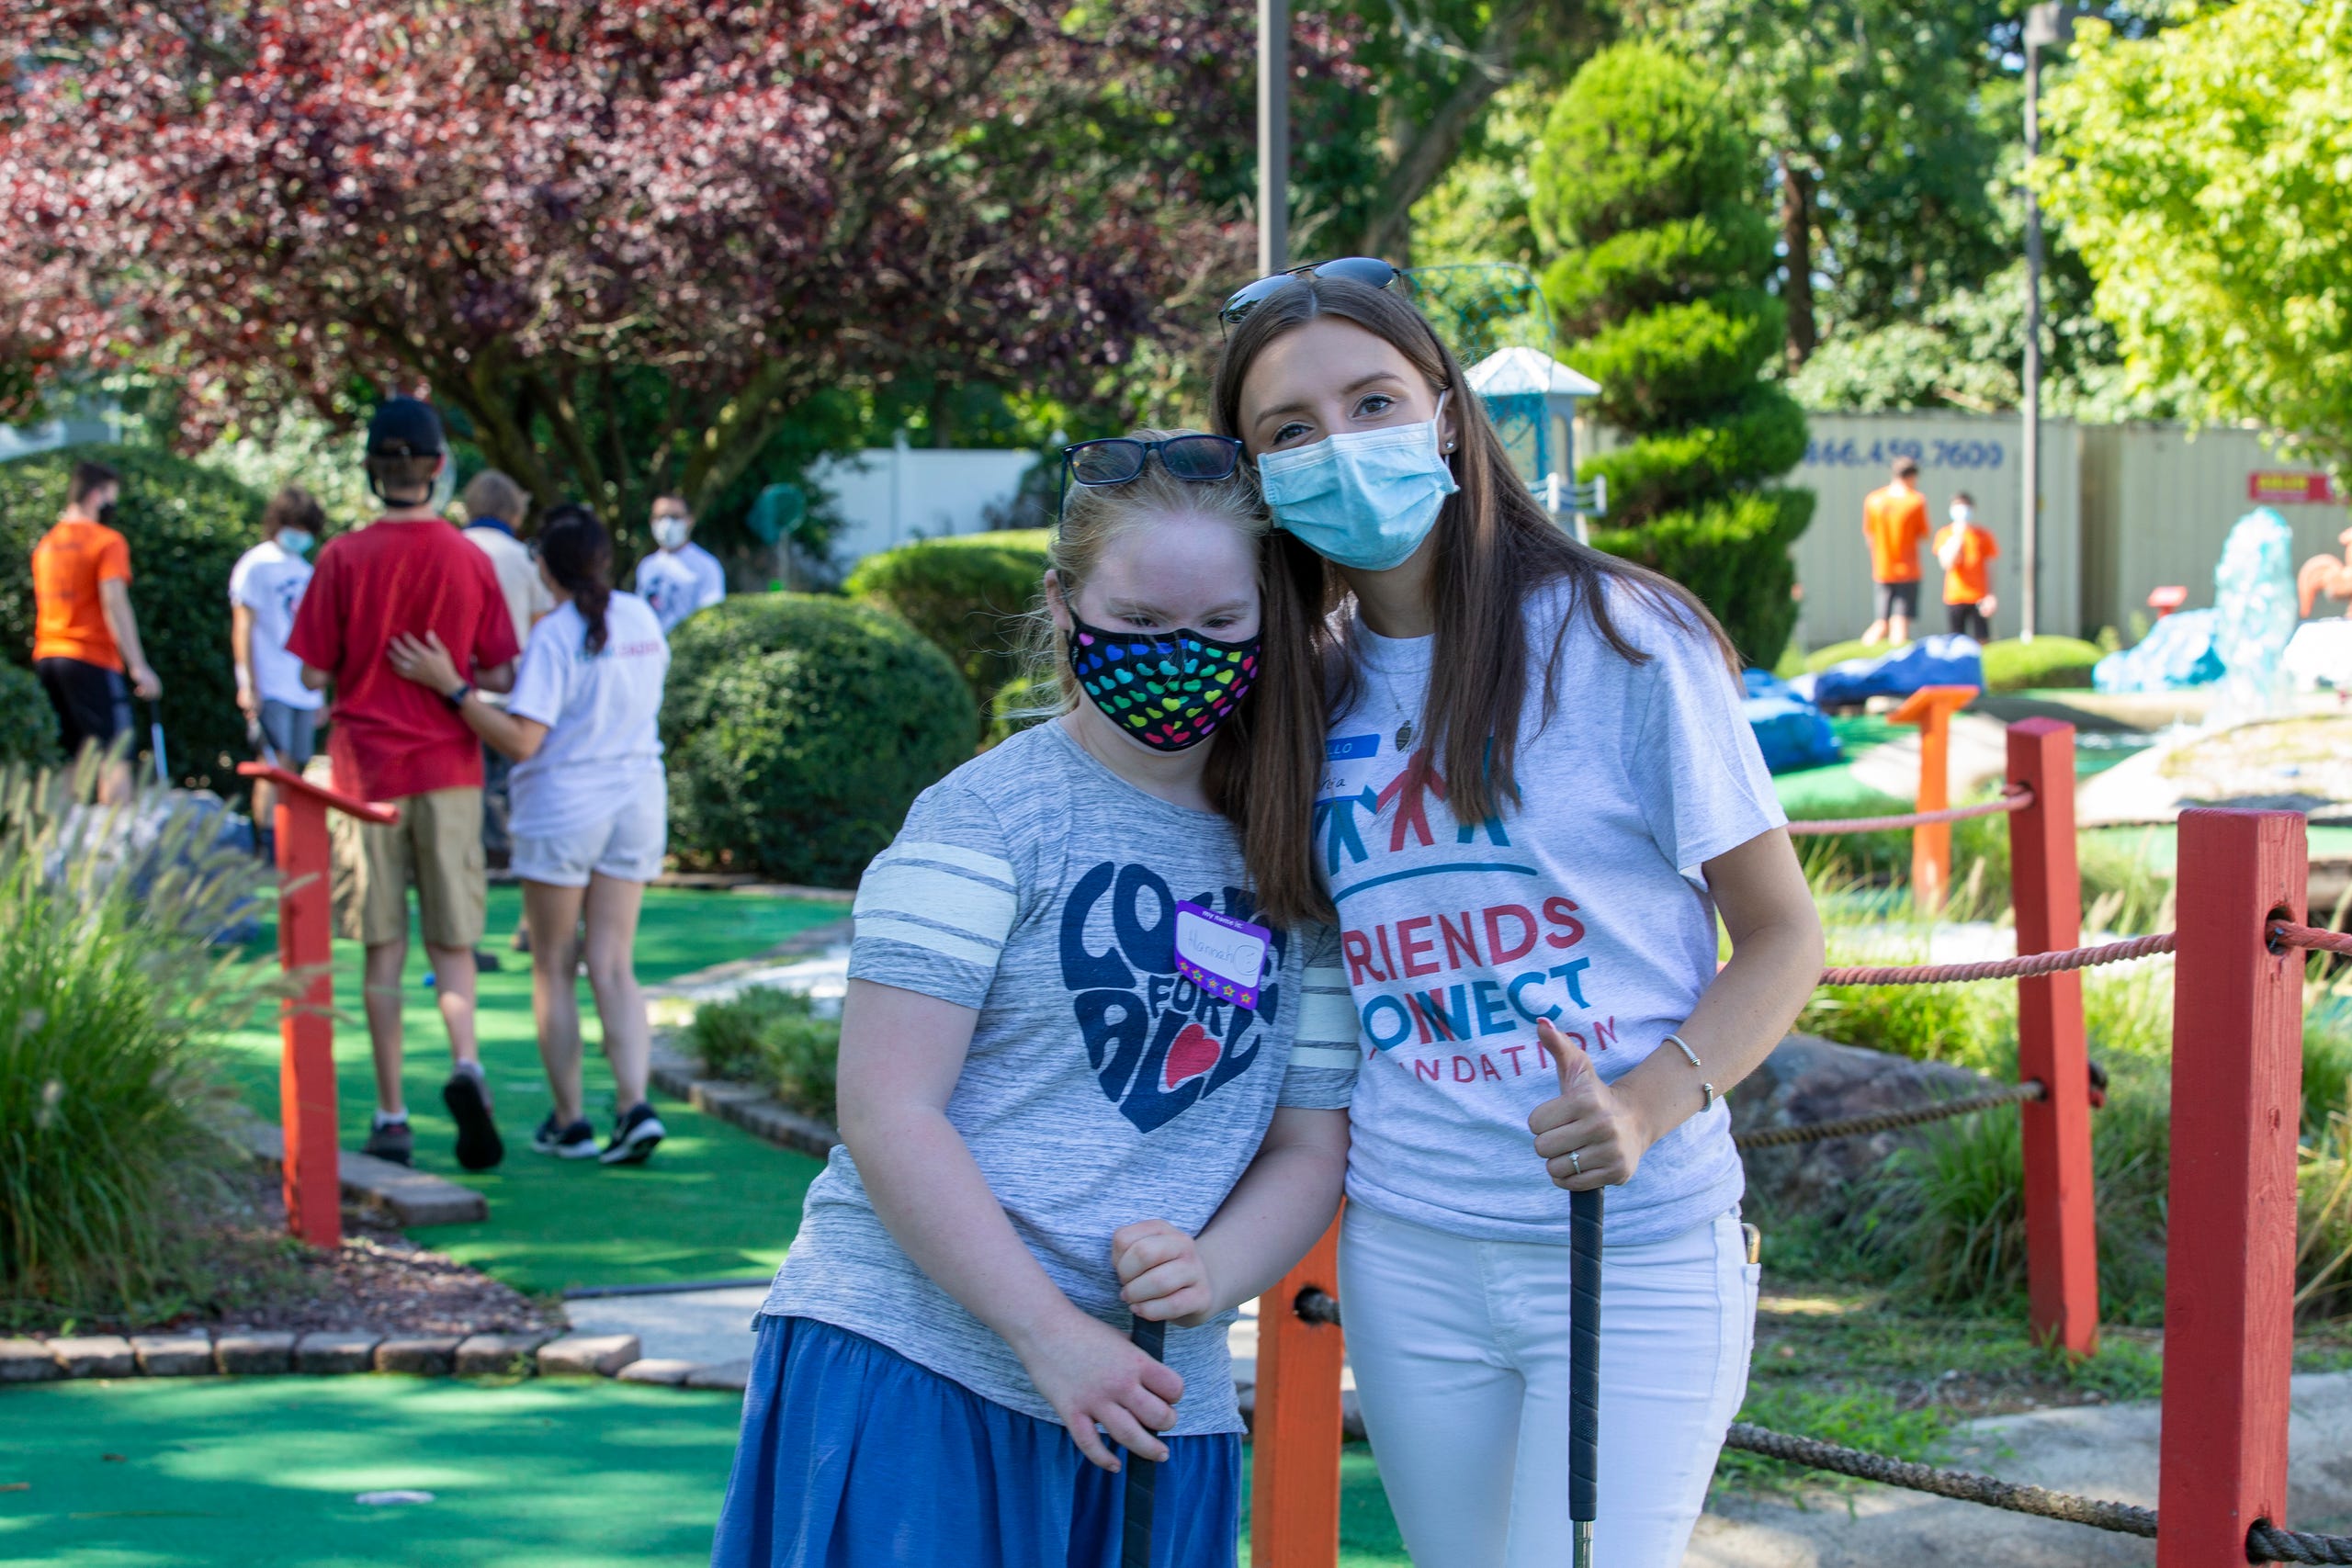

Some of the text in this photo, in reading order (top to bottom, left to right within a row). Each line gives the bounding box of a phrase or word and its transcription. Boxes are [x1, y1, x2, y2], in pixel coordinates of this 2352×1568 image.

[1341, 896, 1586, 987] RIENDS
[1148, 975, 1227, 1037] FOR
[1362, 956, 1591, 1052] ONNECT
[1074, 989, 1261, 1134] ALL
